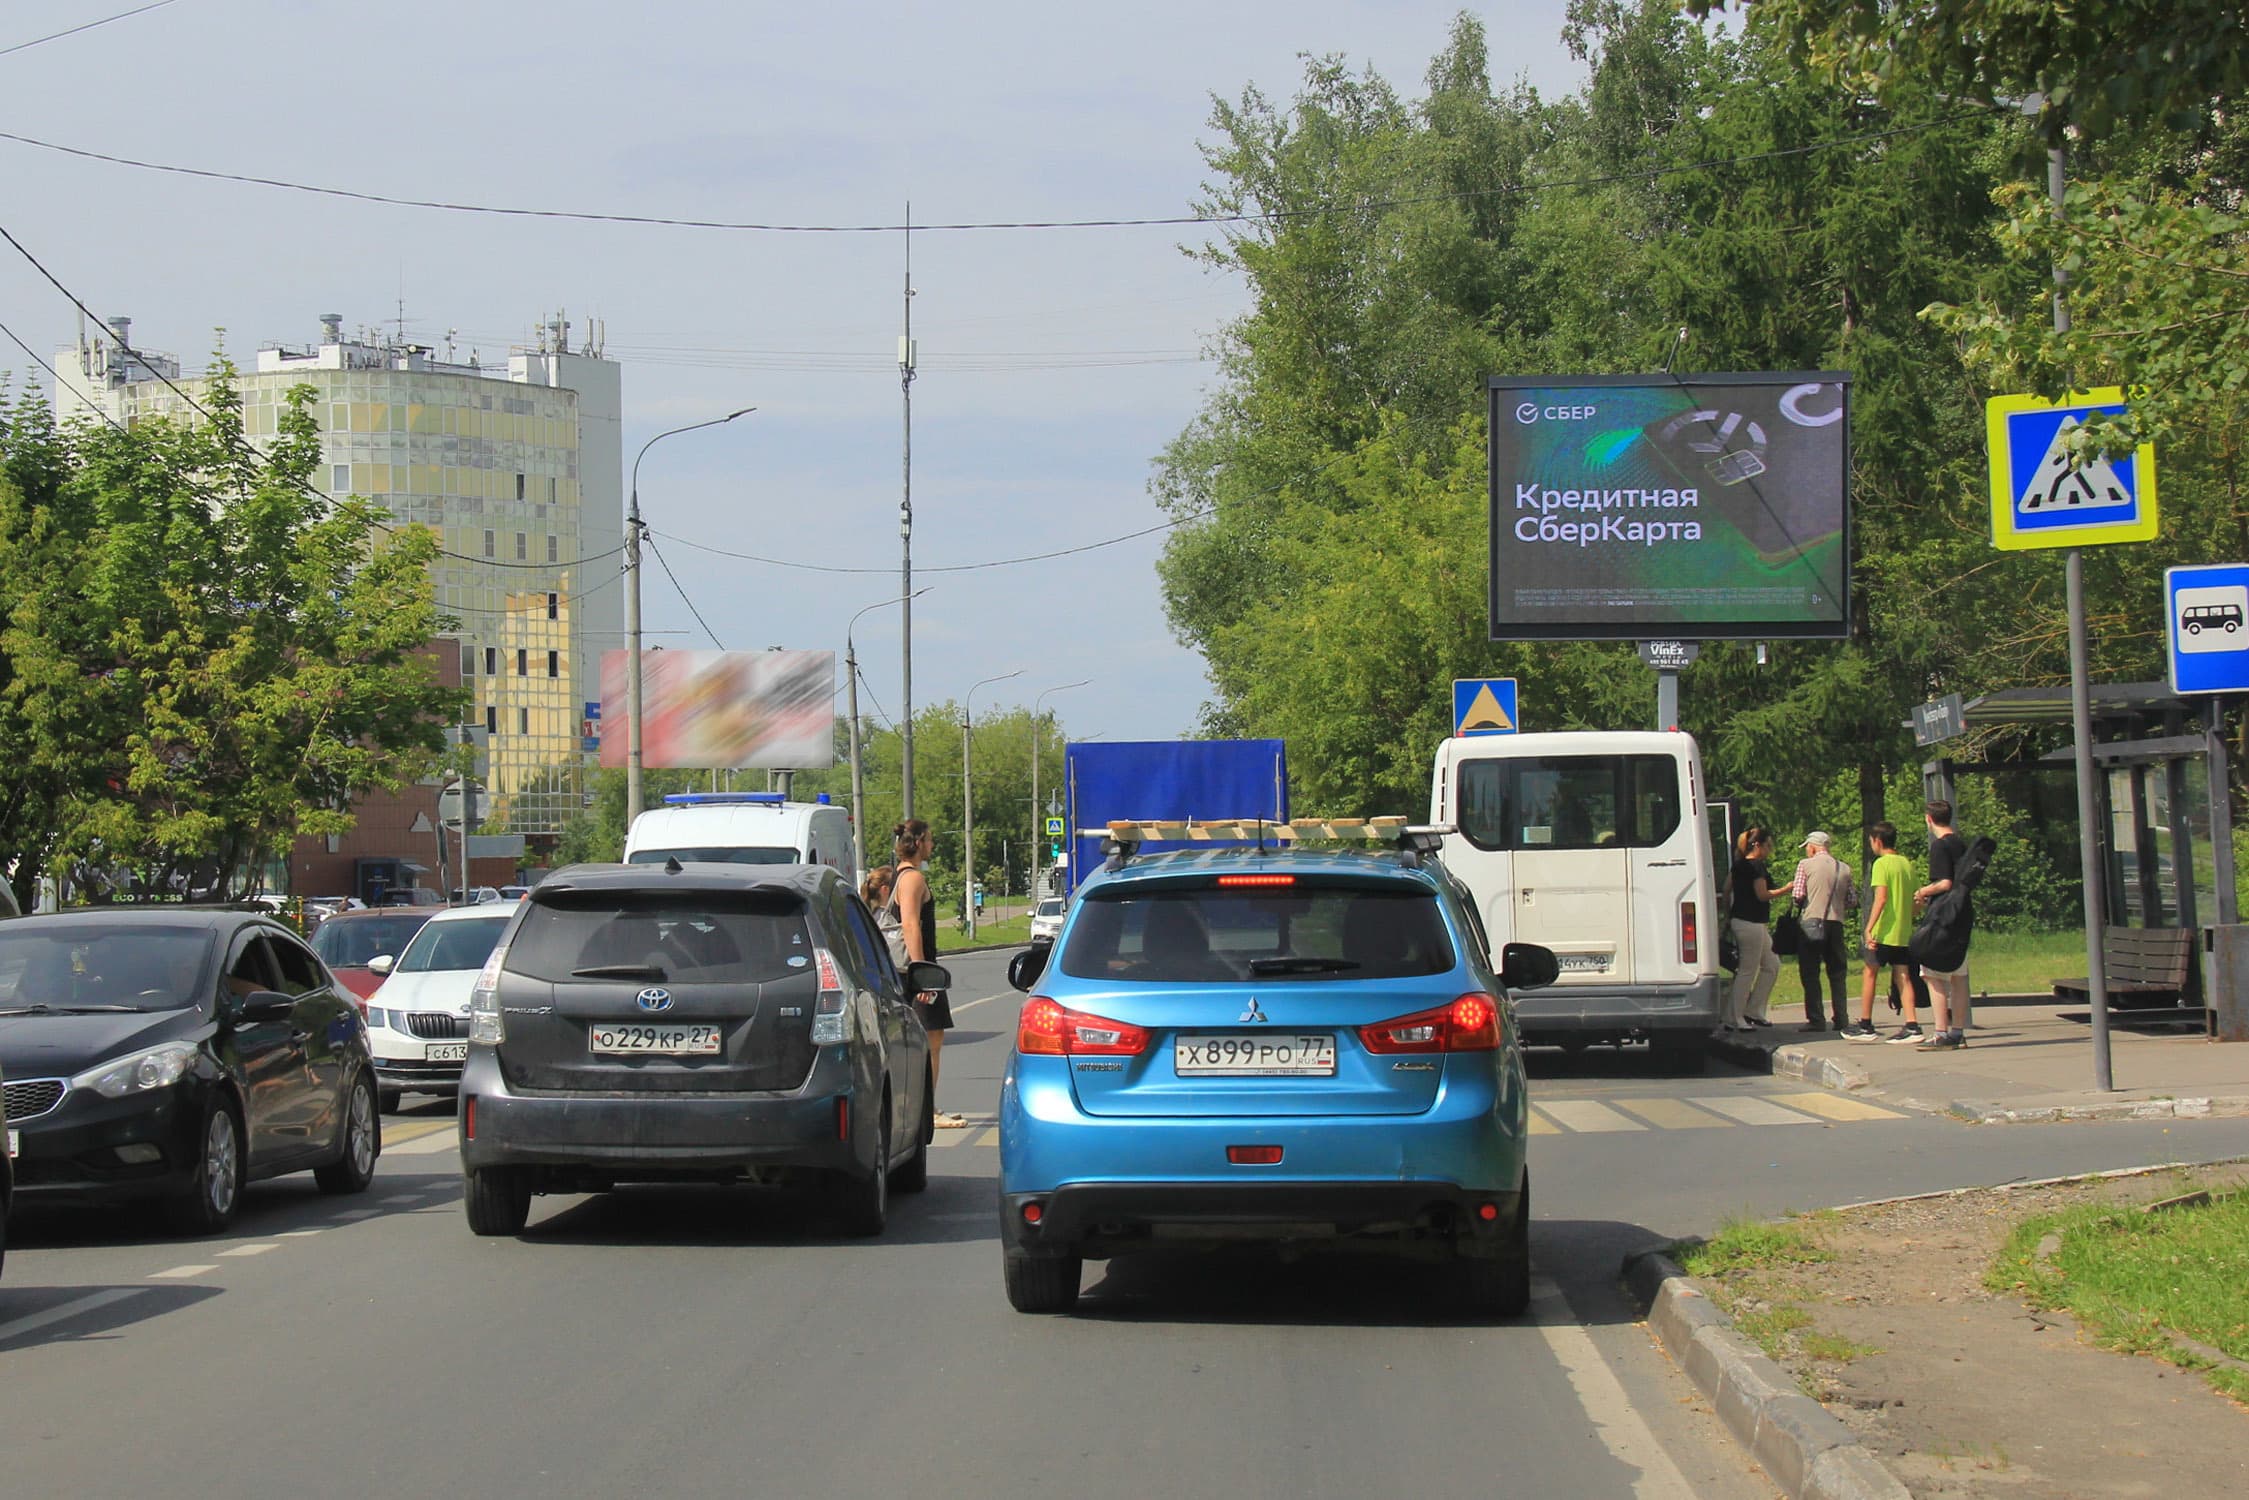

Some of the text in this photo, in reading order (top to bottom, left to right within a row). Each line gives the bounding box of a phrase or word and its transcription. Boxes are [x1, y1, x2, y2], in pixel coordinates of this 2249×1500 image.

[1544, 406, 1596, 420] СБЕР
[1515, 483, 1698, 514] Кредитная
[1514, 514, 1701, 547] СберКарта
[1650, 644, 1684, 656] VinEx
[112, 894, 183, 902] ECO FTNESS
[1558, 958, 1586, 969] 14УК
[691, 1027, 711, 1043] 27
[433, 1046, 466, 1059] С613
[1300, 1038, 1325, 1057] 77
[1297, 1057, 1317, 1065] RUS
